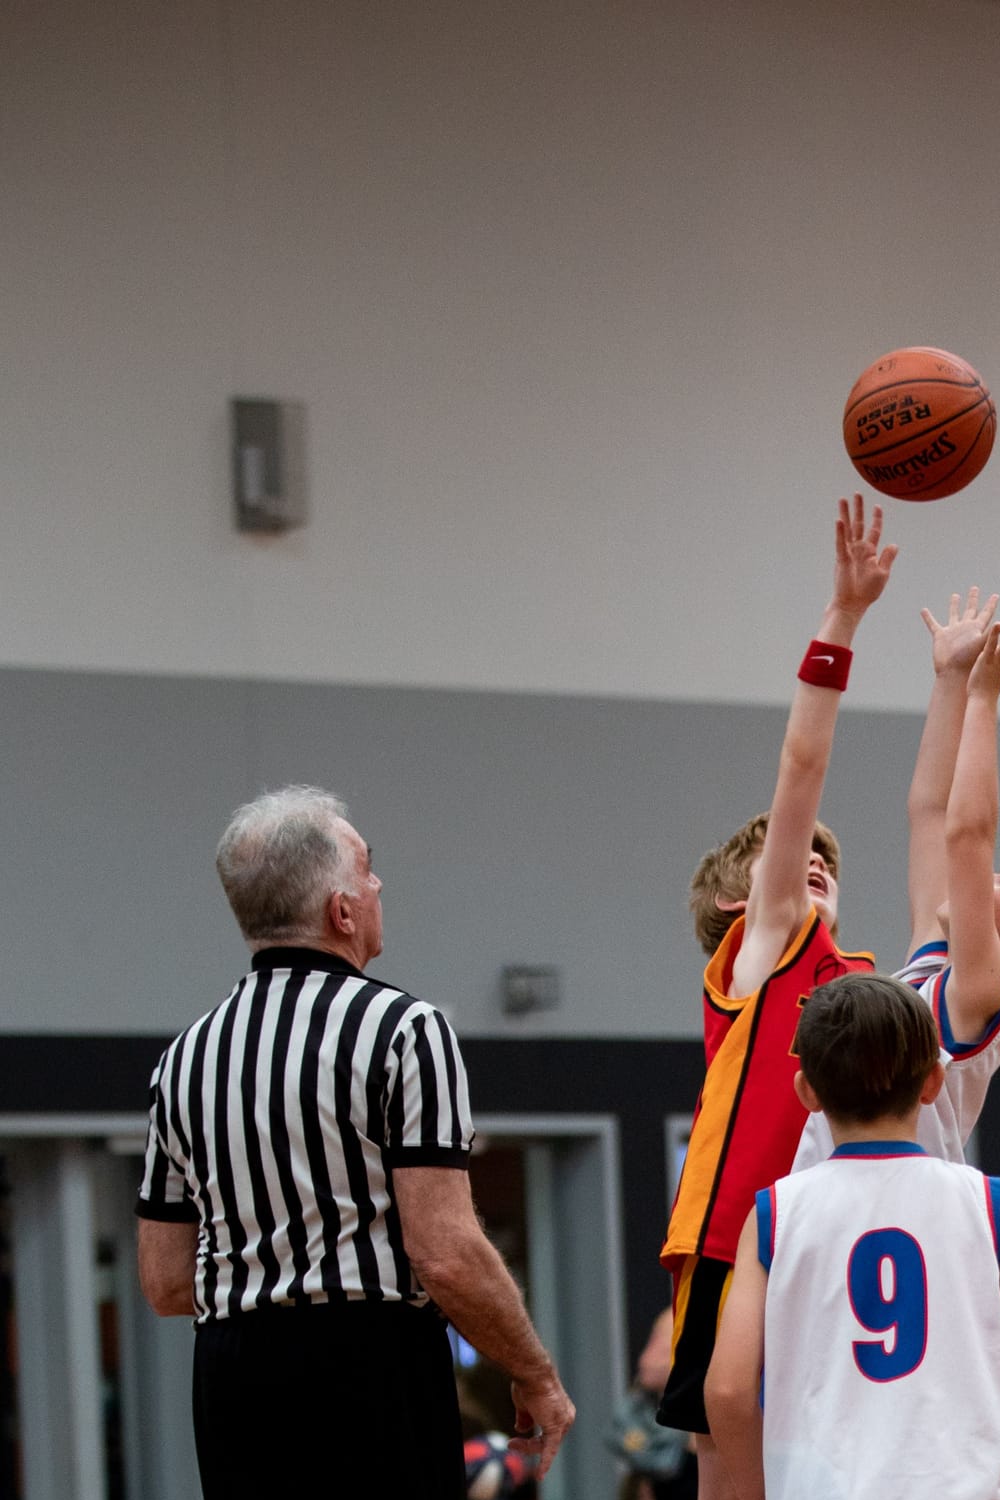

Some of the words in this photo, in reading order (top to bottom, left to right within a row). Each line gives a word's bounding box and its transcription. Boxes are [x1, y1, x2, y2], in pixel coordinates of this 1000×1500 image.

[858, 404, 931, 446] REACT
[863, 431, 956, 482] SPALDING
[847, 1227, 928, 1383] 9
